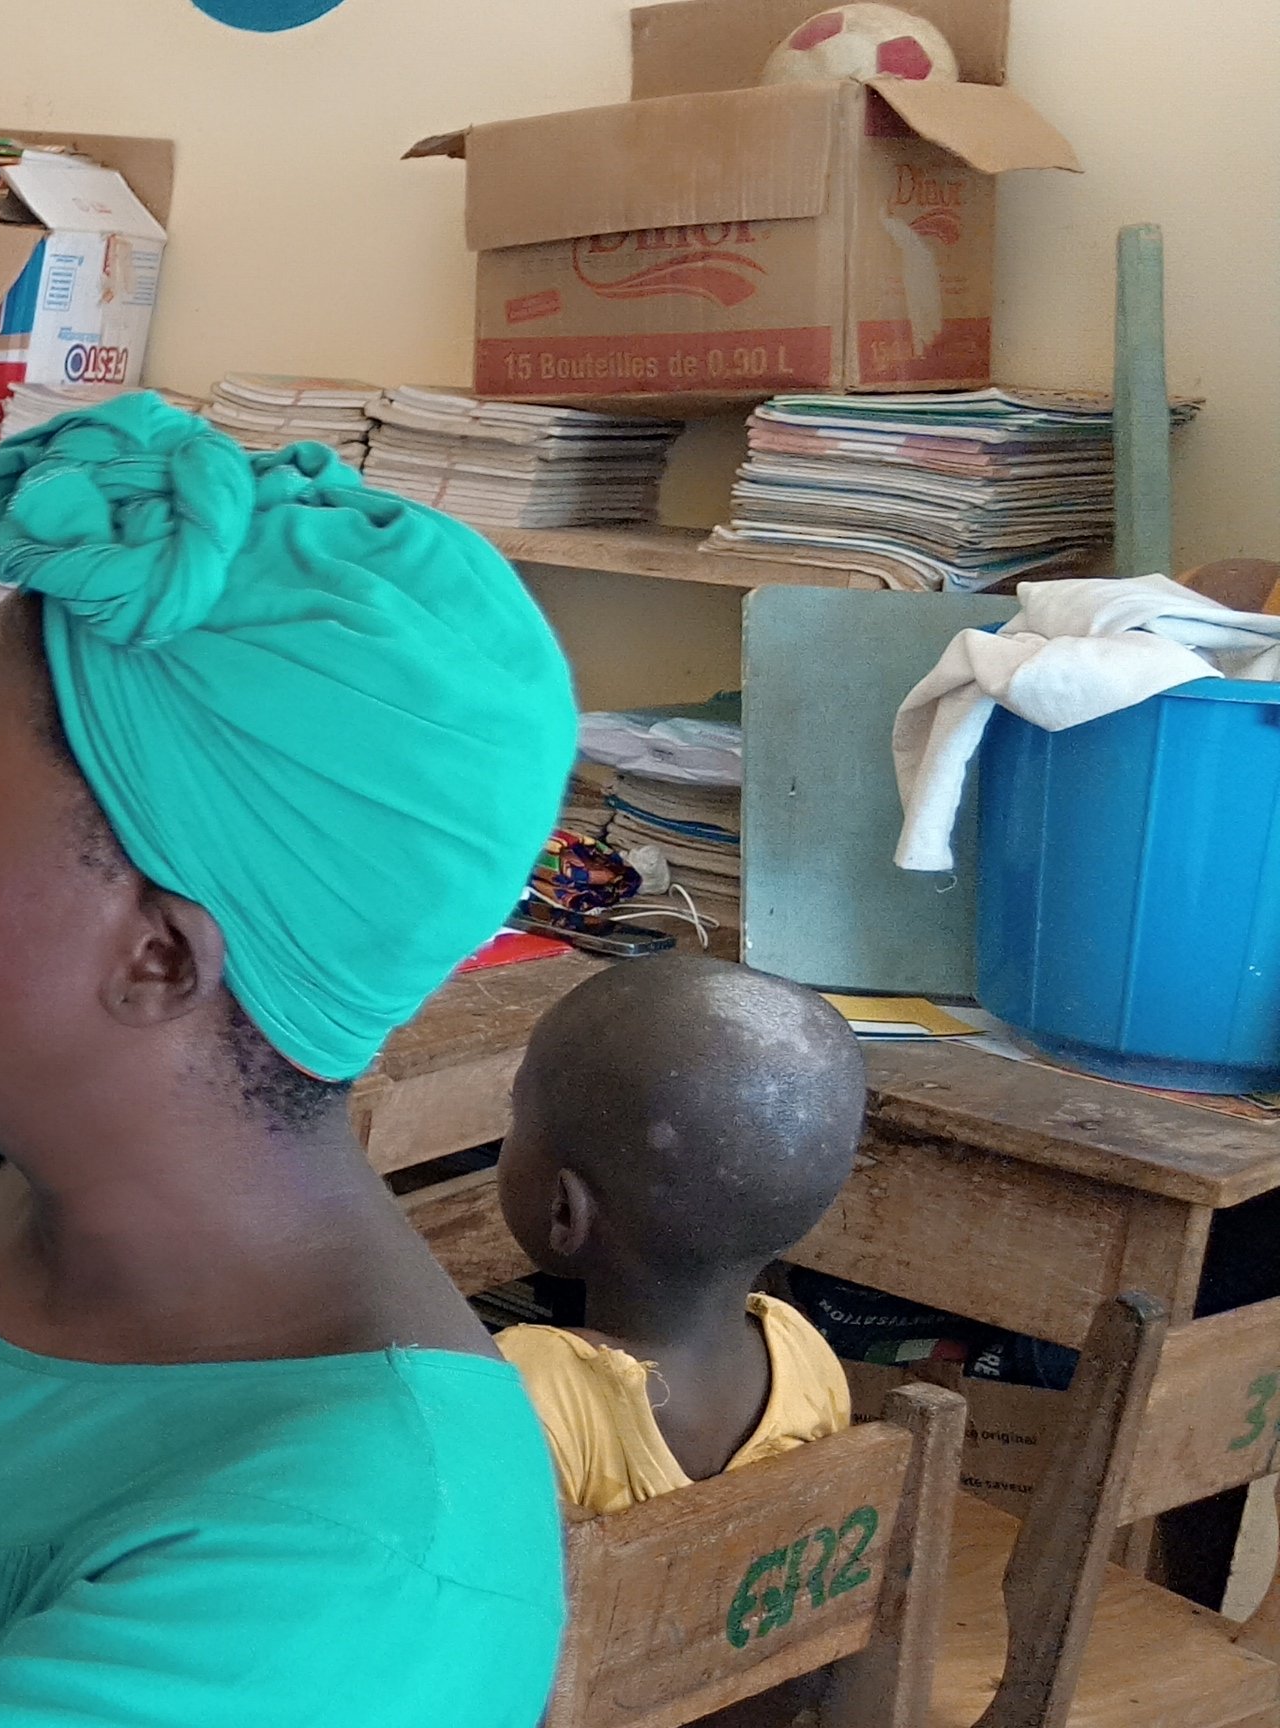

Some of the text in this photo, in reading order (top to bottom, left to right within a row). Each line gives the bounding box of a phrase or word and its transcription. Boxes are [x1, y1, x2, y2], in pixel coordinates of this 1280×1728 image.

[64, 344, 129, 384] FESTO
[504, 353, 532, 381] 15
[541, 350, 659, 380] Bouteilles
[668, 350, 698, 379] de
[777, 345, 794, 375] L
